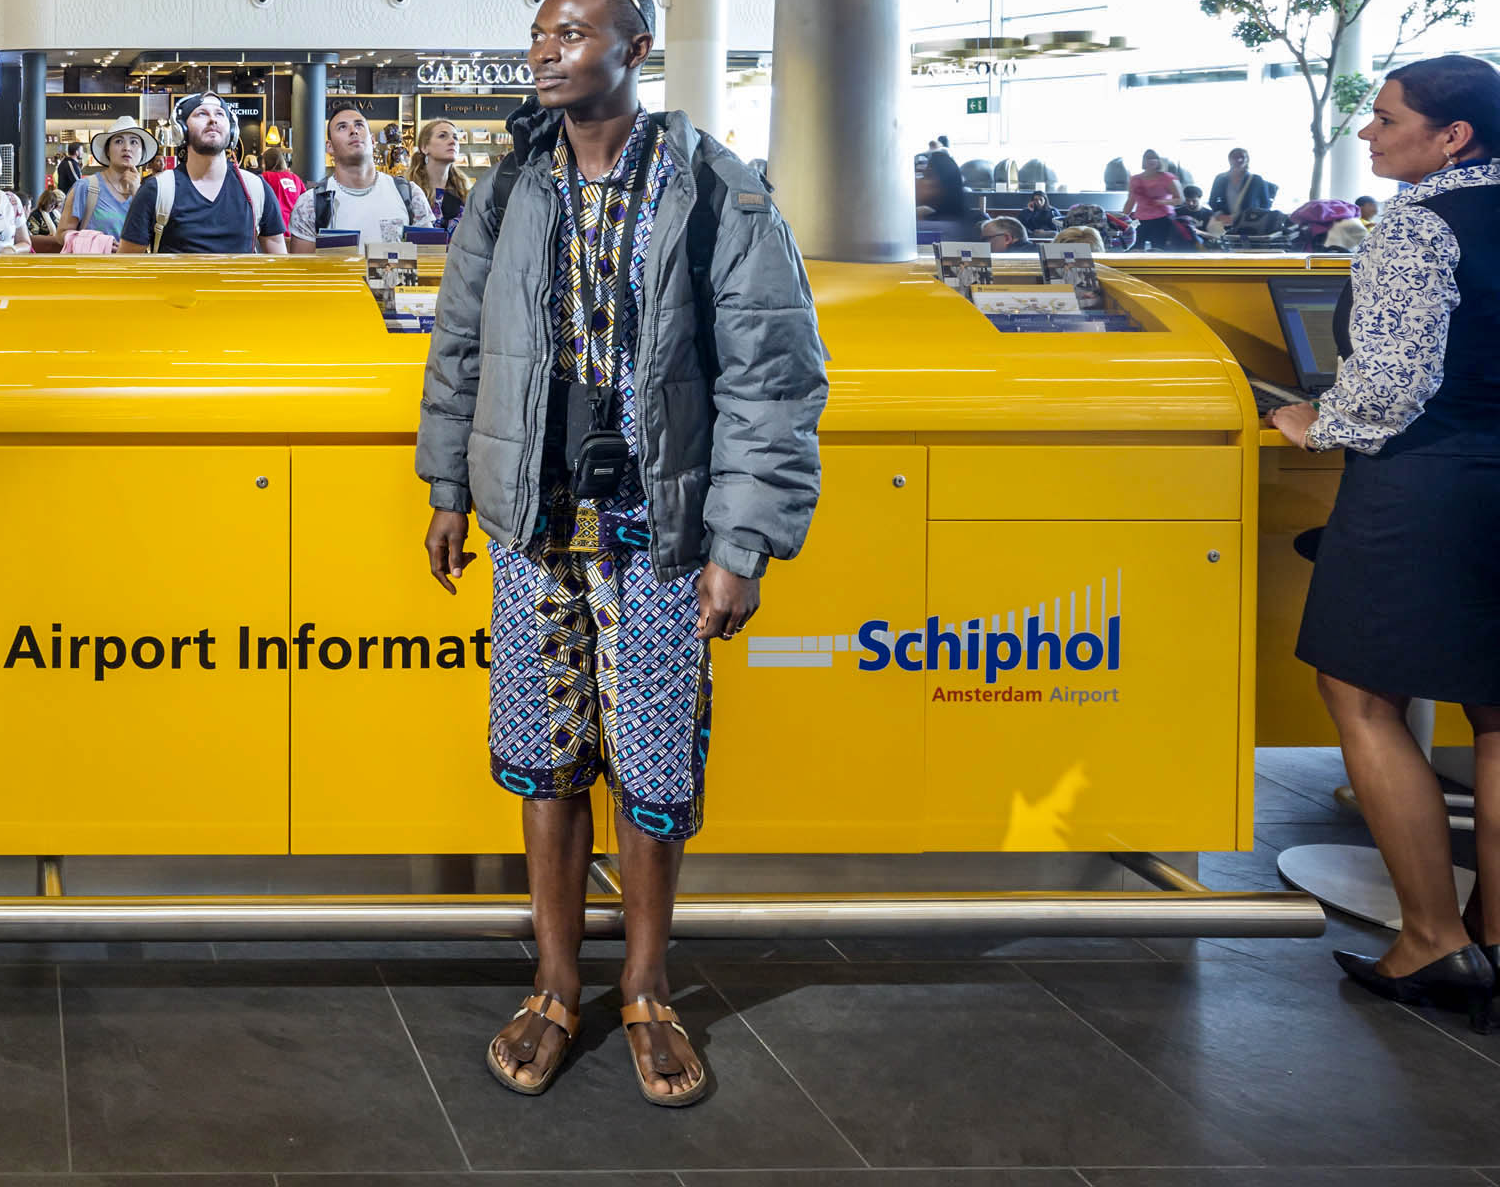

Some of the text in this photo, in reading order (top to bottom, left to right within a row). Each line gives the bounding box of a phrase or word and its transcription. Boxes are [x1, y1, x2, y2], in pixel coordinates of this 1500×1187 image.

[483, 63, 535, 84] COC
[3, 622, 490, 681] Airport Informat
[857, 615, 1120, 683] Schiphol
[931, 685, 1119, 706] Amsterdam Airport
